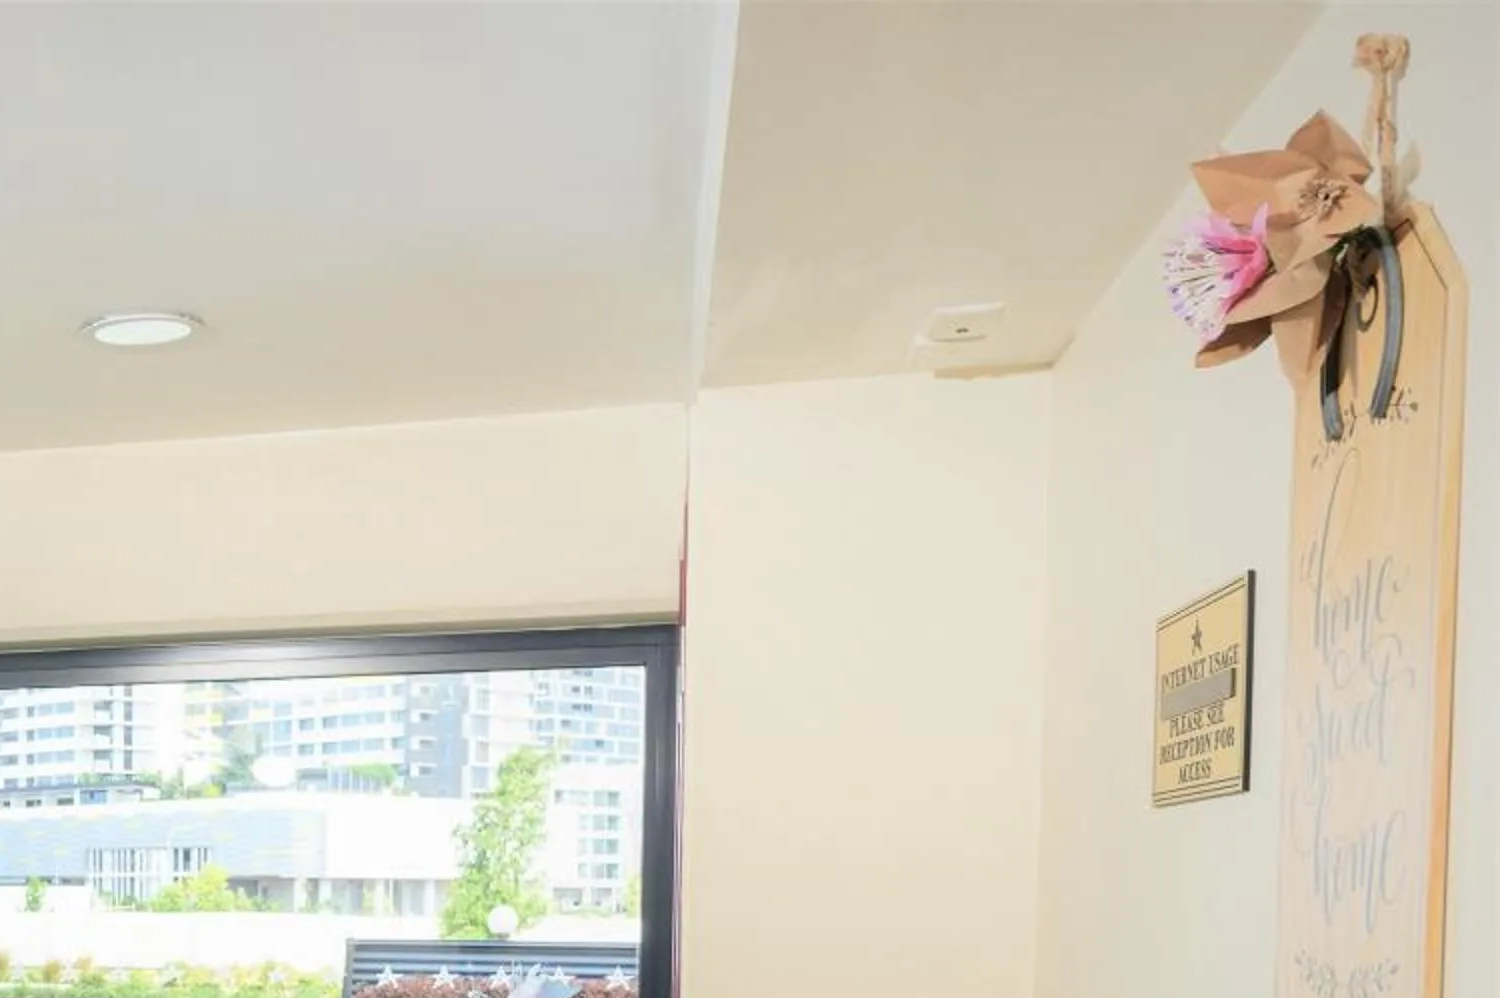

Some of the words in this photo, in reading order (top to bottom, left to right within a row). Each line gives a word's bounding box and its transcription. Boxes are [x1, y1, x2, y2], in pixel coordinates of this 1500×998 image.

[1161, 655, 1206, 694] INTERNET
[1159, 731, 1212, 766] RECEPTION
[1214, 726, 1236, 751] FOR
[1178, 758, 1212, 785] ACCESS
